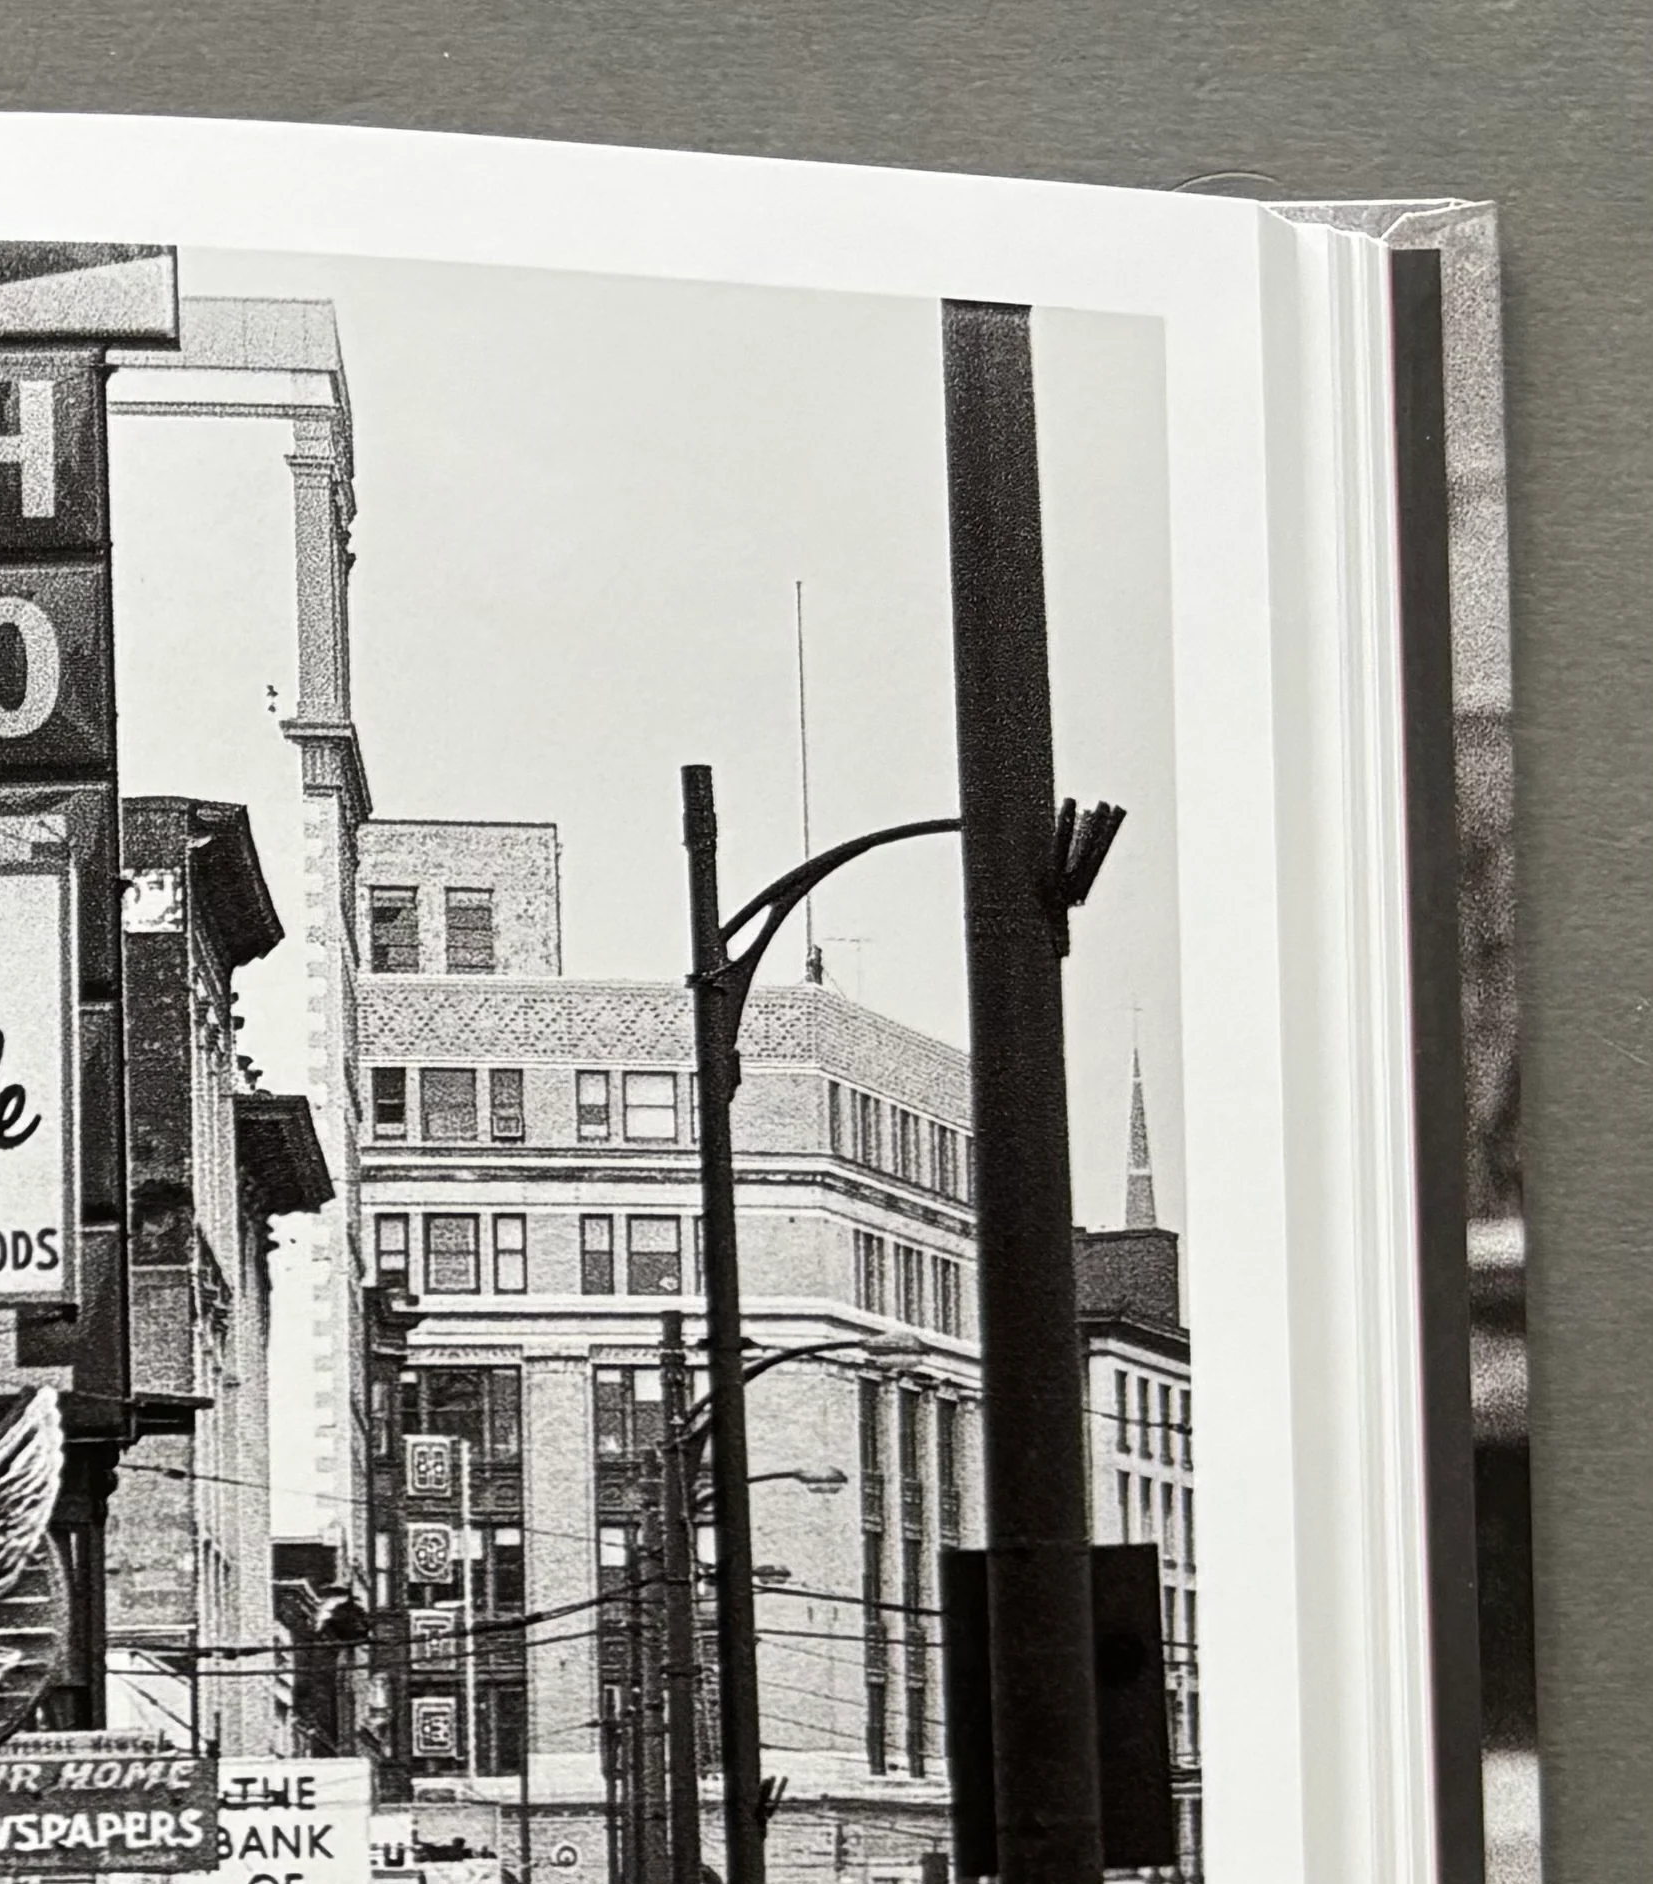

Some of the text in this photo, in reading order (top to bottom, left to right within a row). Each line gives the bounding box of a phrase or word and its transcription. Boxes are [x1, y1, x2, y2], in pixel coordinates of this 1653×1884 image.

[58, 1760, 200, 1791] HOME
[230, 1776, 317, 1811] THE
[216, 1824, 335, 1861] BANK
